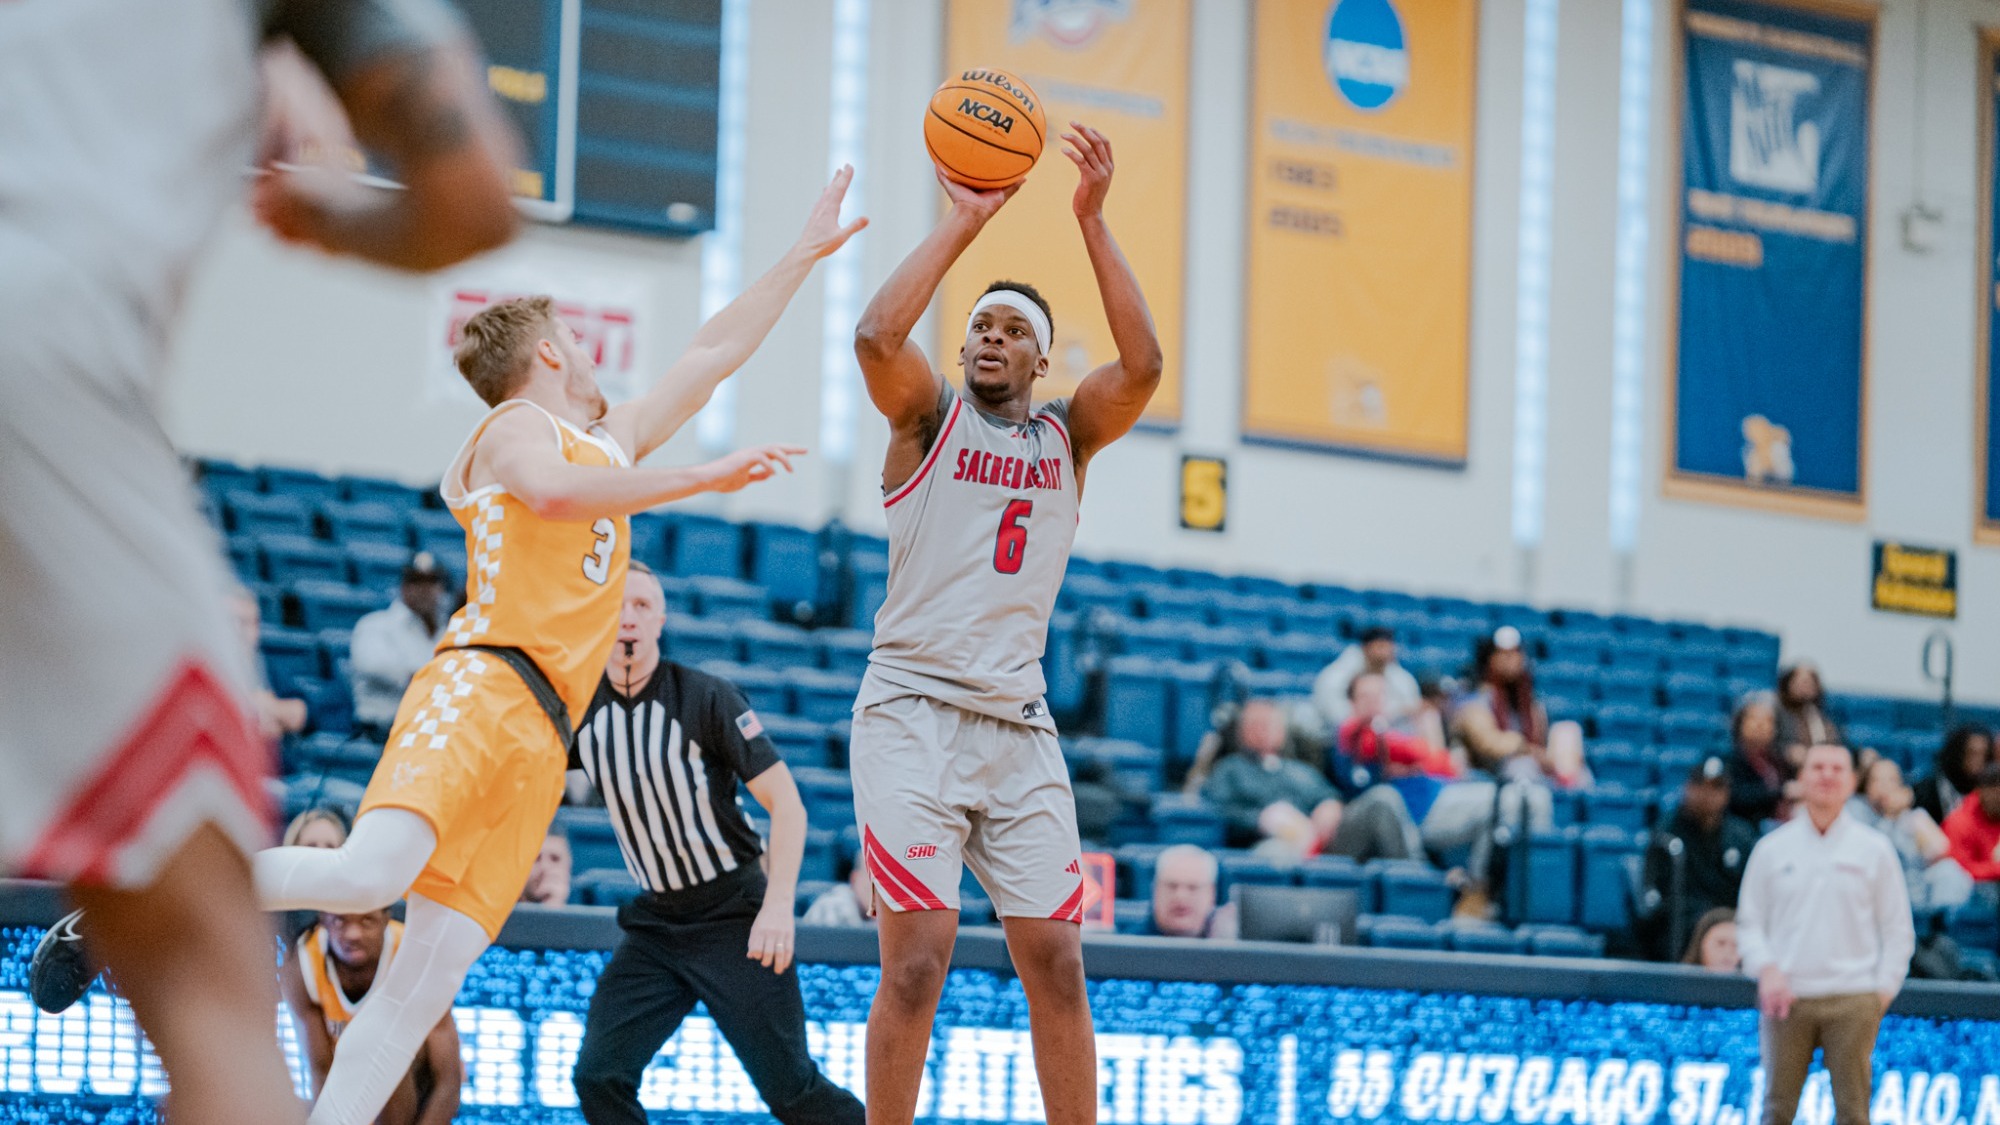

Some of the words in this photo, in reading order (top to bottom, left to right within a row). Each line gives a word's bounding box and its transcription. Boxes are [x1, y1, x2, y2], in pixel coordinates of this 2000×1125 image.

[957, 98, 1014, 134] NCAA
[961, 70, 1035, 114] Wilson
[953, 448, 1024, 490] SACRED
[1183, 460, 1225, 528] 5
[582, 517, 616, 586] 3
[993, 499, 1033, 574] 6
[905, 843, 938, 859] SHU
[1327, 1049, 1392, 1119] 55
[1403, 1053, 1664, 1125] CHICAGO
